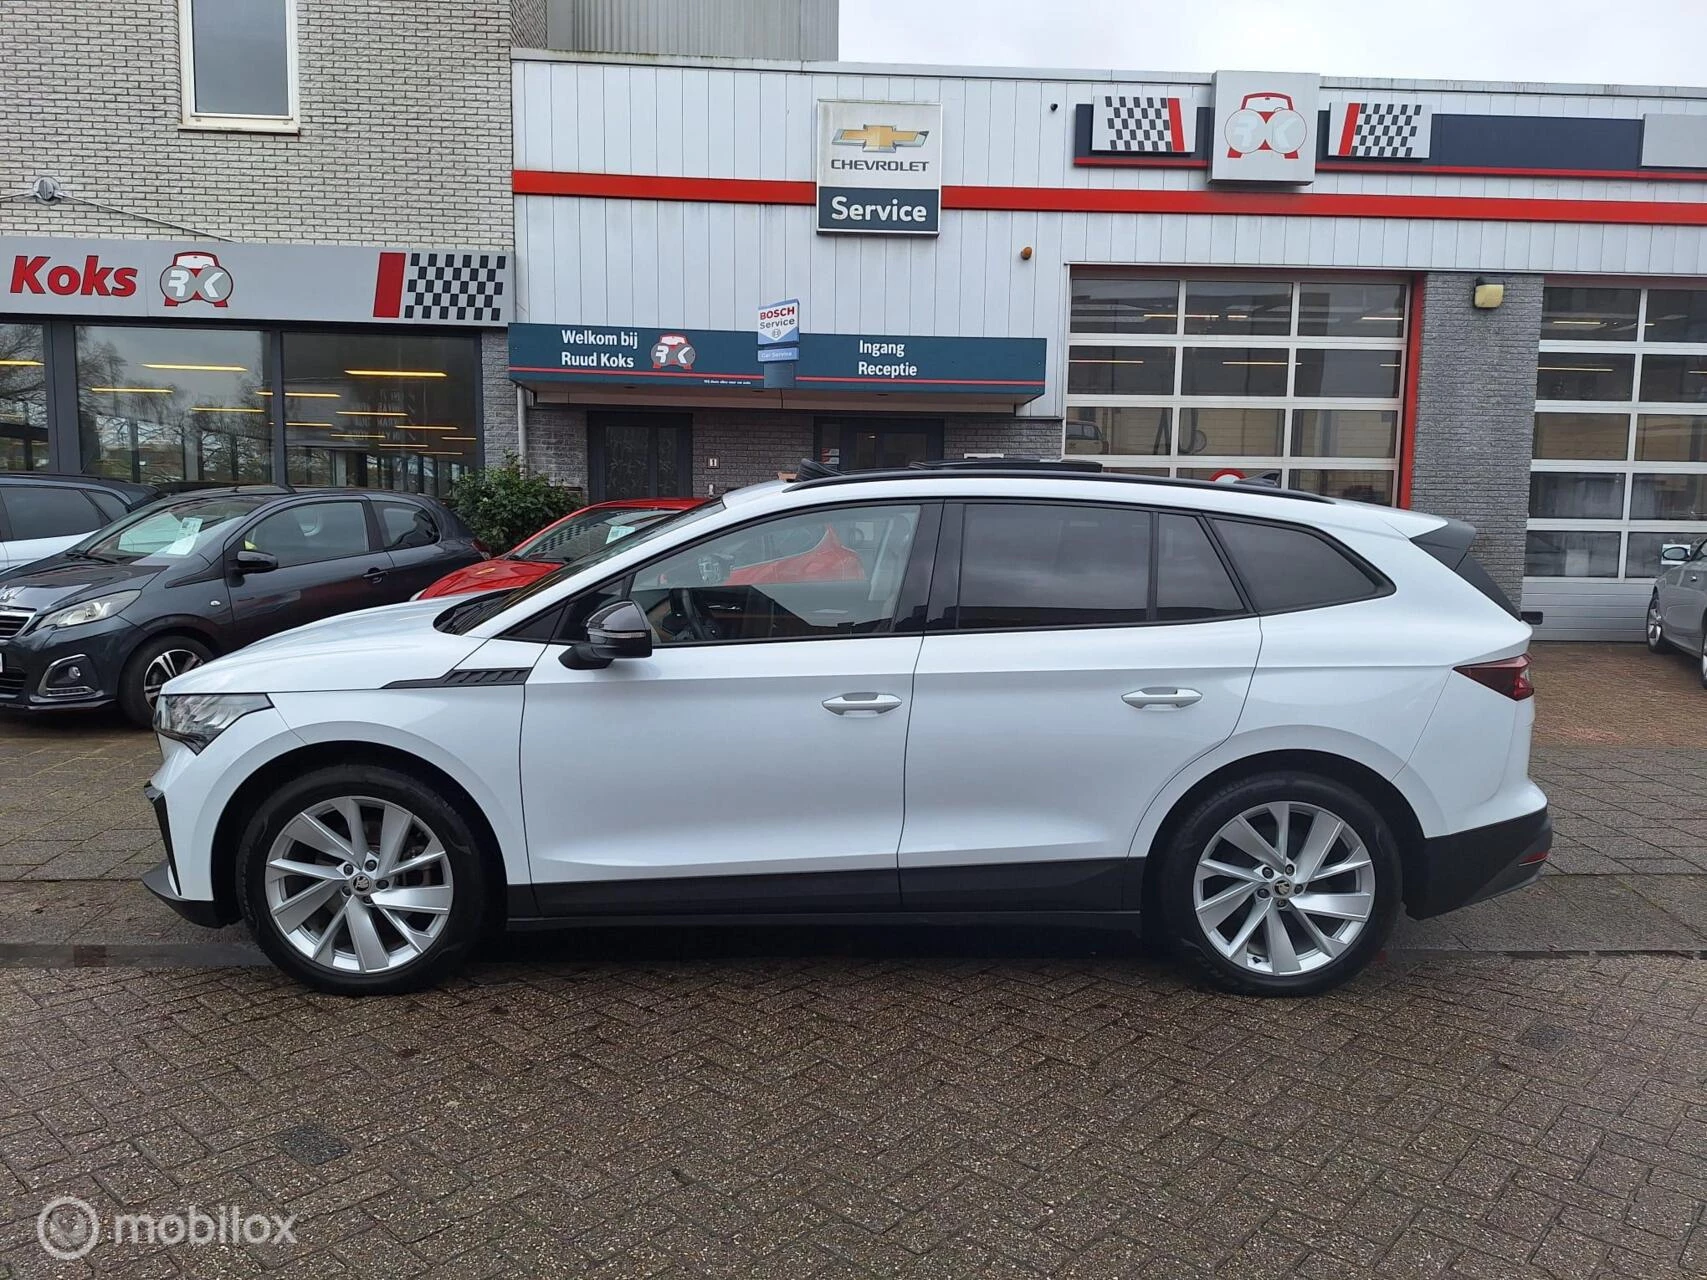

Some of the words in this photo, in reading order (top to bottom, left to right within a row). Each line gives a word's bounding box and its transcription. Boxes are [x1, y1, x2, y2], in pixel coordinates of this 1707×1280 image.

[831, 159, 930, 172] CHEVROLET
[831, 195, 927, 222] Service
[10, 255, 138, 297] Koks
[760, 306, 795, 320] BOSCH
[760, 318, 795, 329] Service
[561, 330, 618, 346] Welkom
[620, 332, 638, 349] bij
[859, 339, 905, 357] Ingang
[561, 351, 597, 367] Ruud
[600, 353, 634, 368] Koks
[858, 361, 918, 378] Receptie
